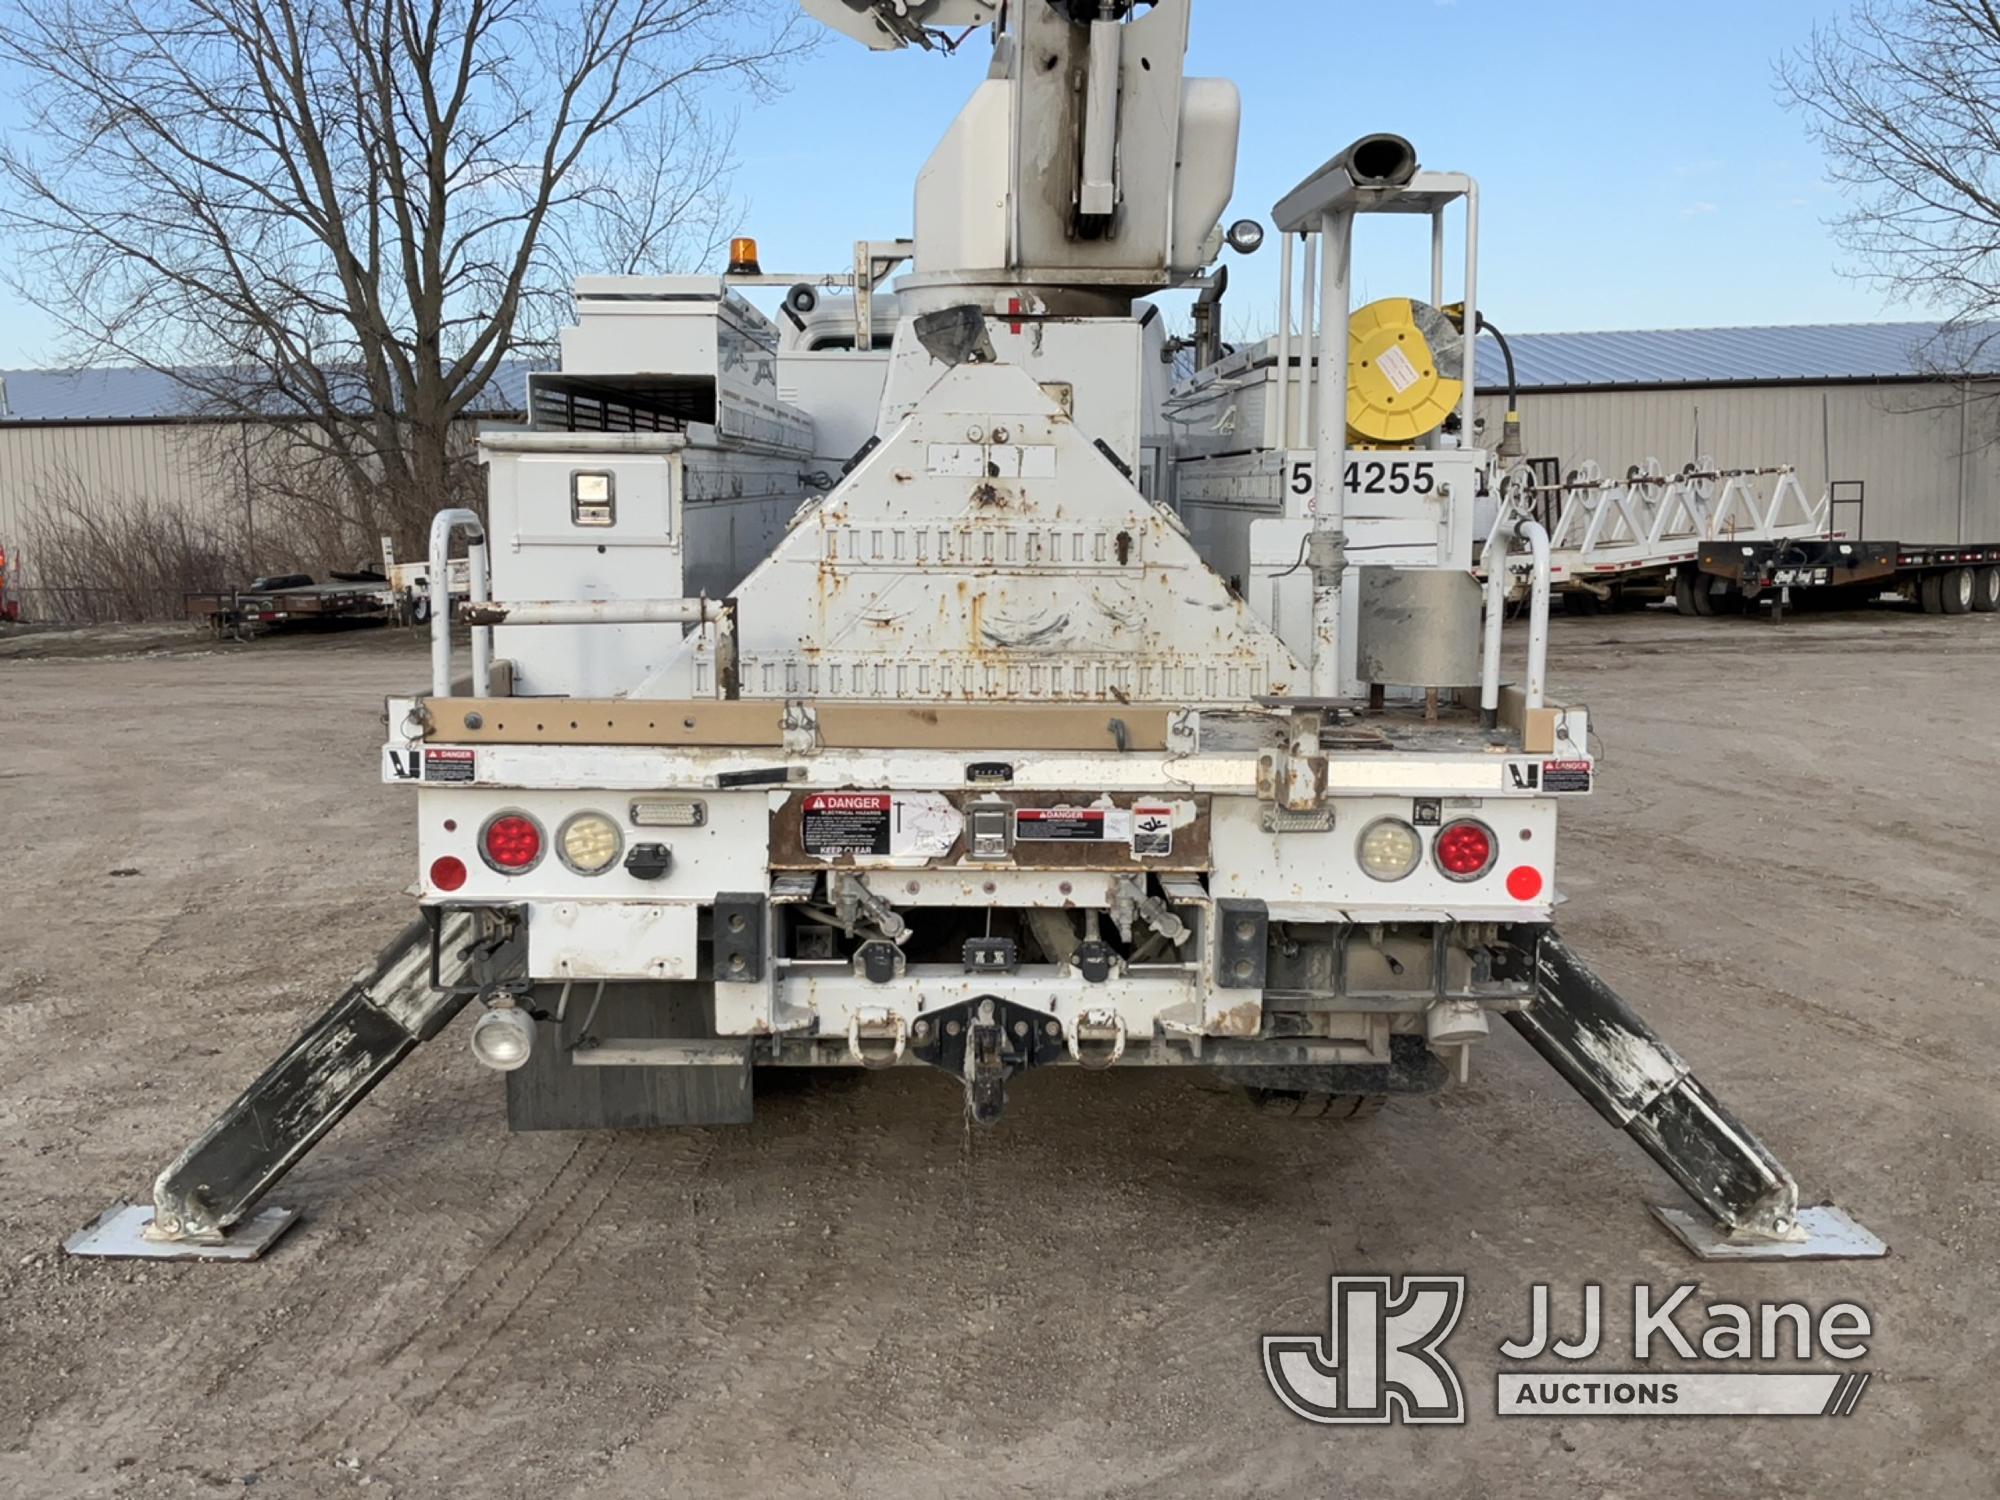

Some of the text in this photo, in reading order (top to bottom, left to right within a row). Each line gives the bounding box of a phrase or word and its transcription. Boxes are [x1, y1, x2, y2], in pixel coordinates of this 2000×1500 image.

[1291, 462, 1434, 494] 54255
[1555, 761, 1587, 769] DANGER
[828, 797, 880, 808] DANGER
[1046, 811, 1083, 819] DANGER
